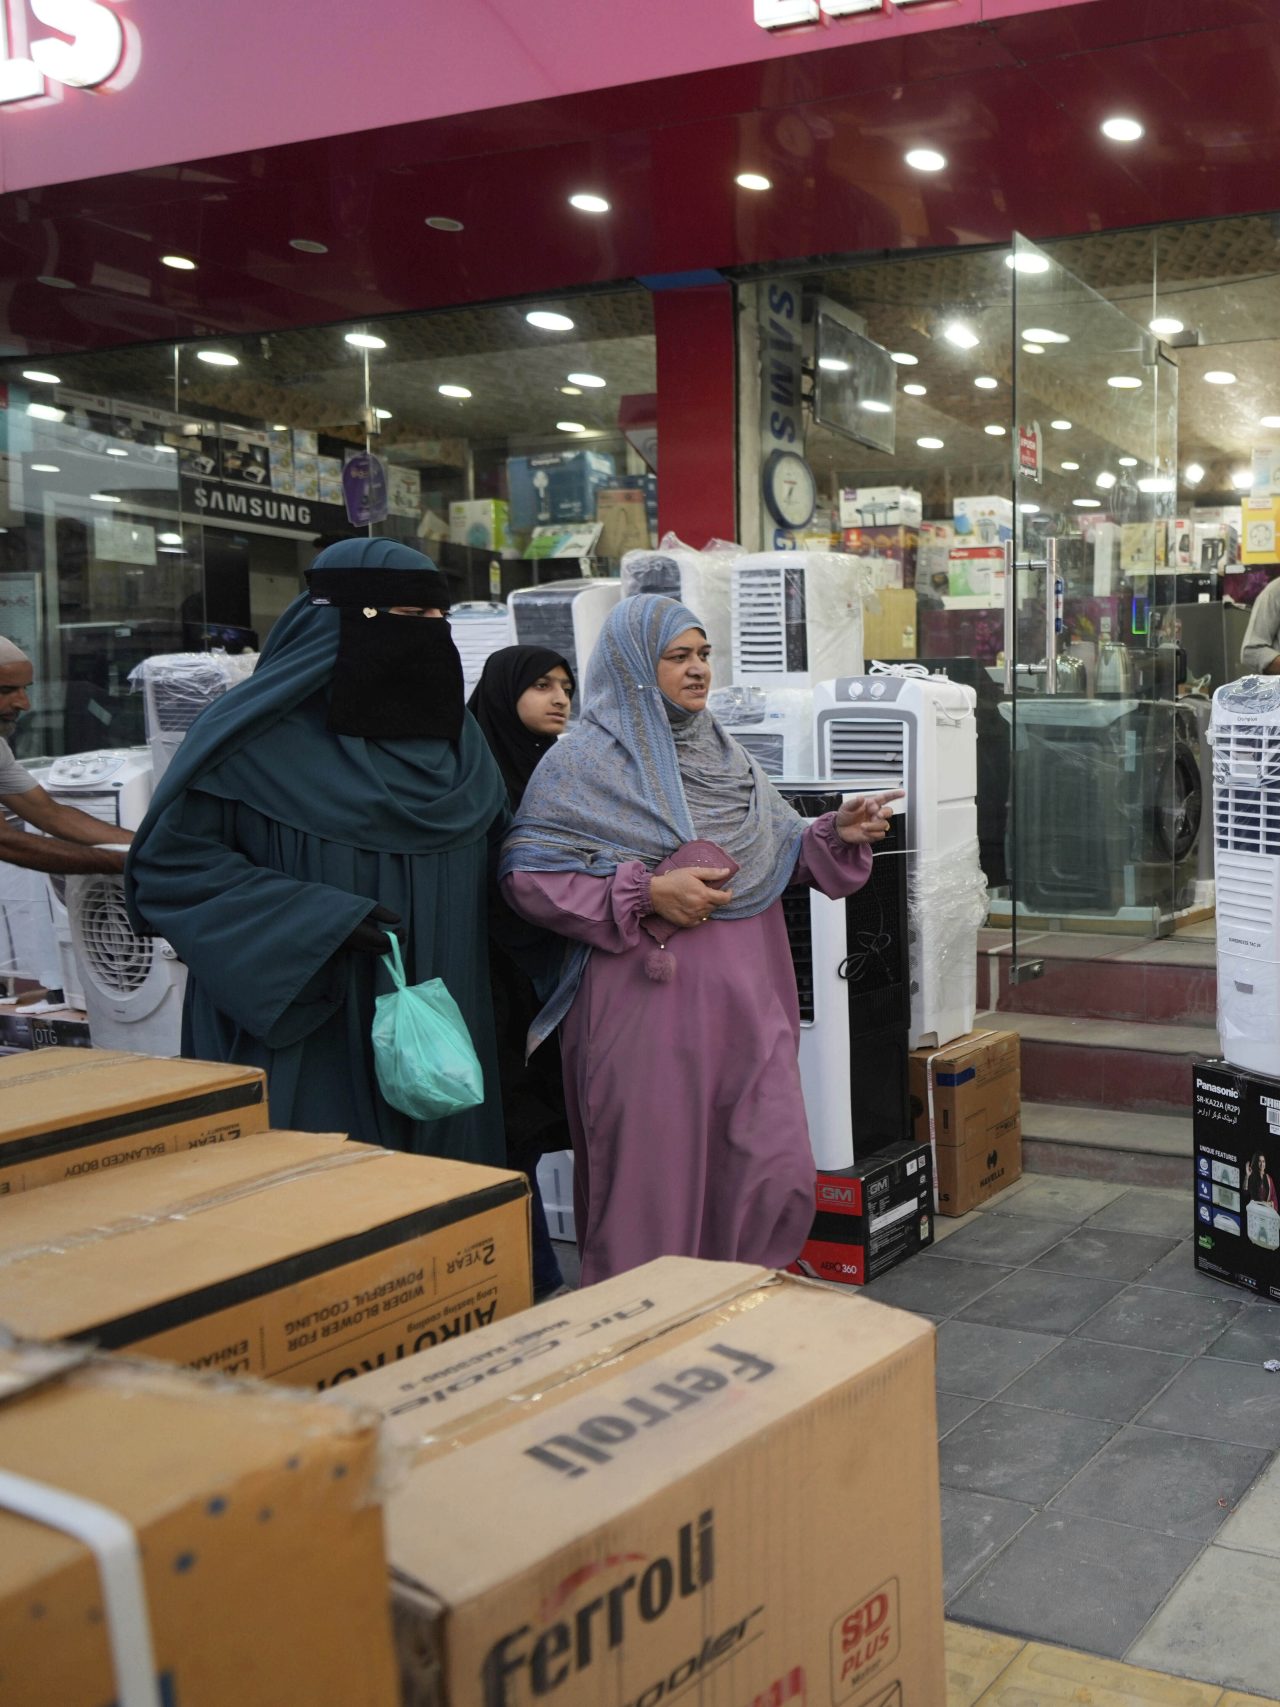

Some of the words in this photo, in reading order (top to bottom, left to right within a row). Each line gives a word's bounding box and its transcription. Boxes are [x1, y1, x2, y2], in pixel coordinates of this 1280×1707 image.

[194, 487, 311, 525] SAMSUNG
[34, 1028, 58, 1045] OTG
[1196, 1078, 1239, 1098] Panasonic
[1197, 1095, 1224, 1109] SR-KA22A
[1225, 1102, 1240, 1115] (R2P)
[101, 1143, 165, 1168] BALANCED
[1199, 1145, 1215, 1156] UNIQUE
[1215, 1148, 1238, 1162] FEATURES
[64, 1160, 99, 1178] BODY
[980, 1166, 1006, 1188] HAVELLS
[821, 1184, 853, 1203] GM
[868, 1177, 889, 1195] GM
[446, 1253, 481, 1275] YEAR
[482, 1244, 495, 1266] 2
[352, 1268, 425, 1307] POWERFUL
[475, 1286, 498, 1302] Long
[382, 1285, 425, 1315] WIDER
[443, 1296, 474, 1317] lasting
[284, 1301, 349, 1336] COOLING
[320, 1304, 380, 1338] BLOWER
[406, 1310, 441, 1333] cooling
[287, 1327, 318, 1352] FOR
[387, 1338, 561, 1418] Coole
[522, 1342, 777, 1479] Ferroli
[840, 1593, 889, 1654] SD
[839, 1626, 891, 1683] PLUS
